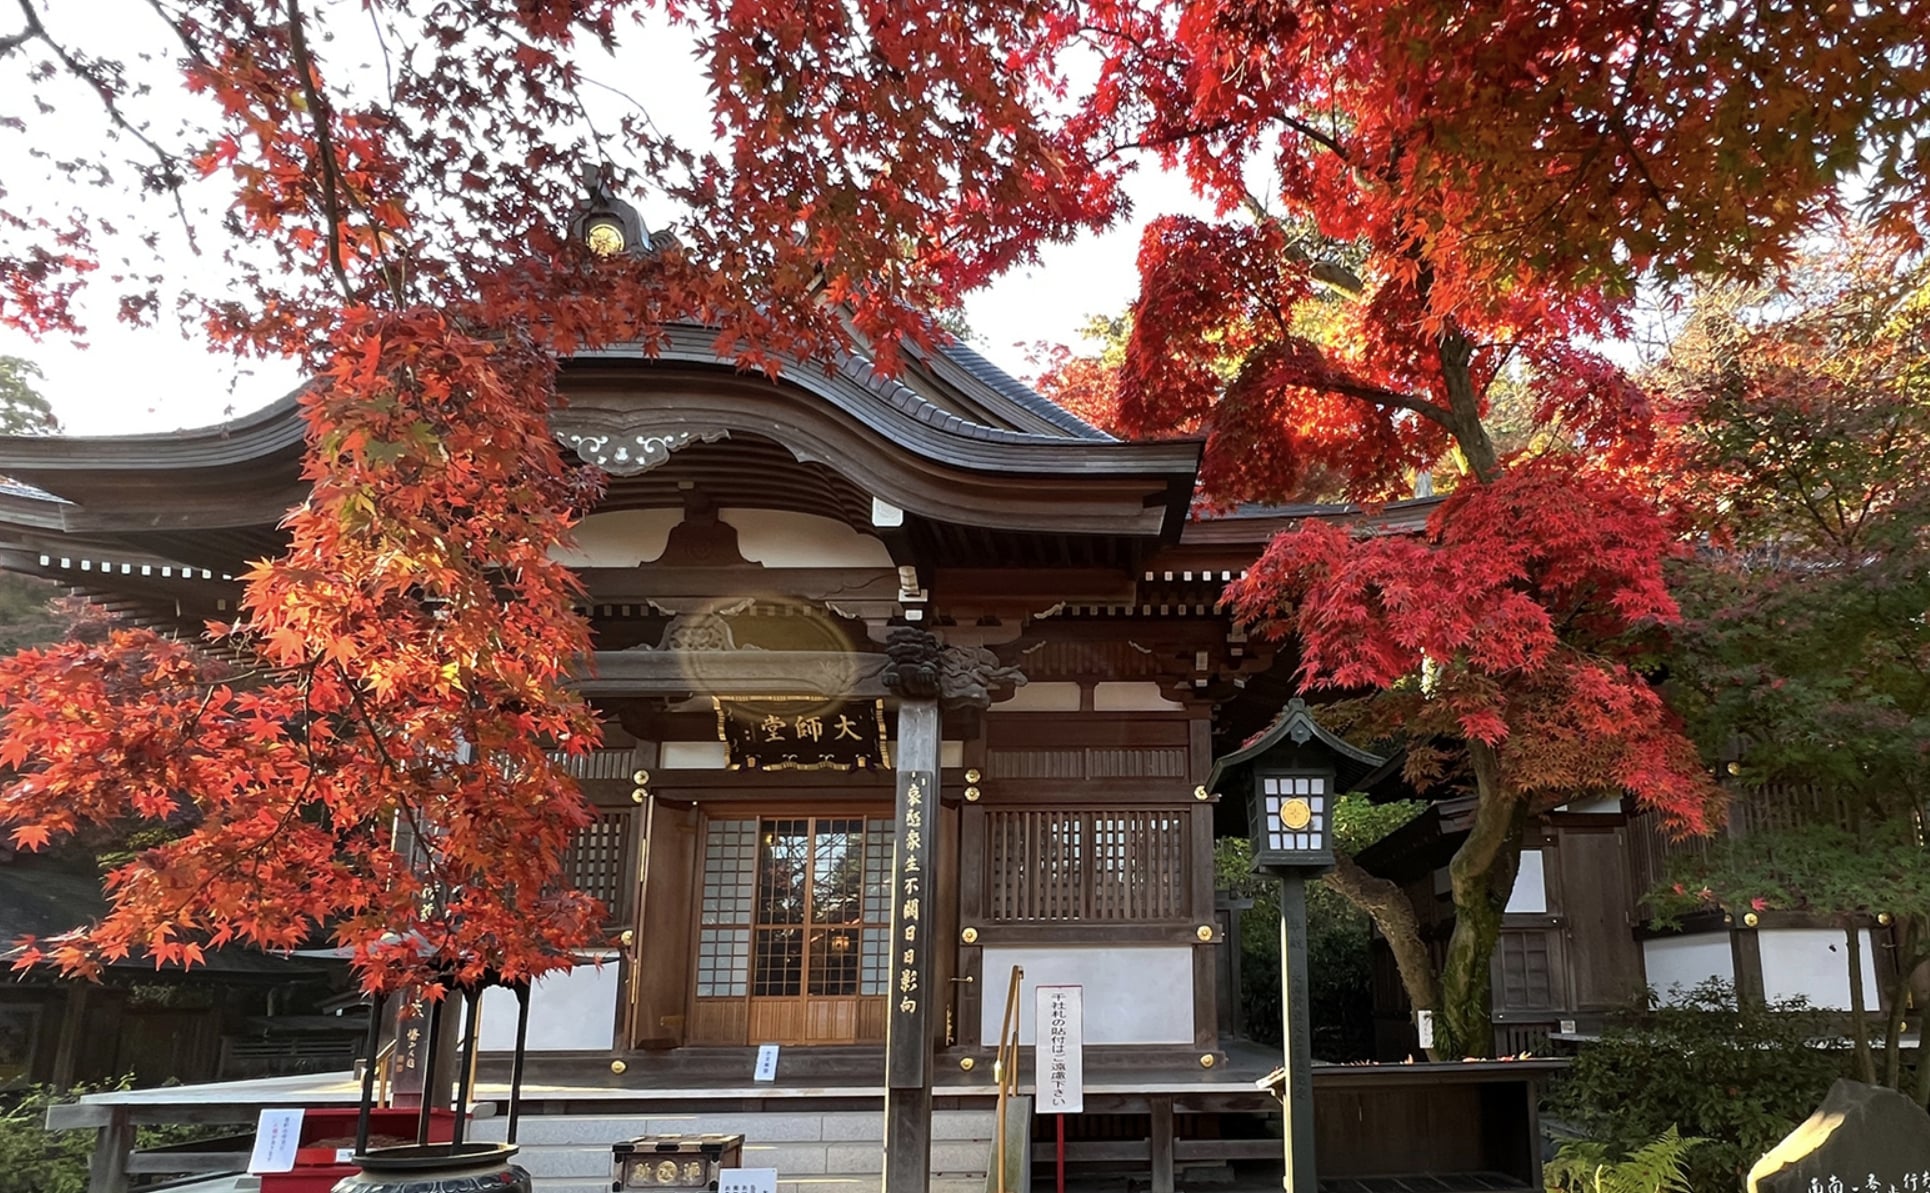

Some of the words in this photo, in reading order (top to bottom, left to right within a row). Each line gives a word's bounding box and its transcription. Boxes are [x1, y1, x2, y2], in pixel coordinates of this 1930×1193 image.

[1051, 992, 1067, 1106] 千社札の貼付はご遠慮下さい
